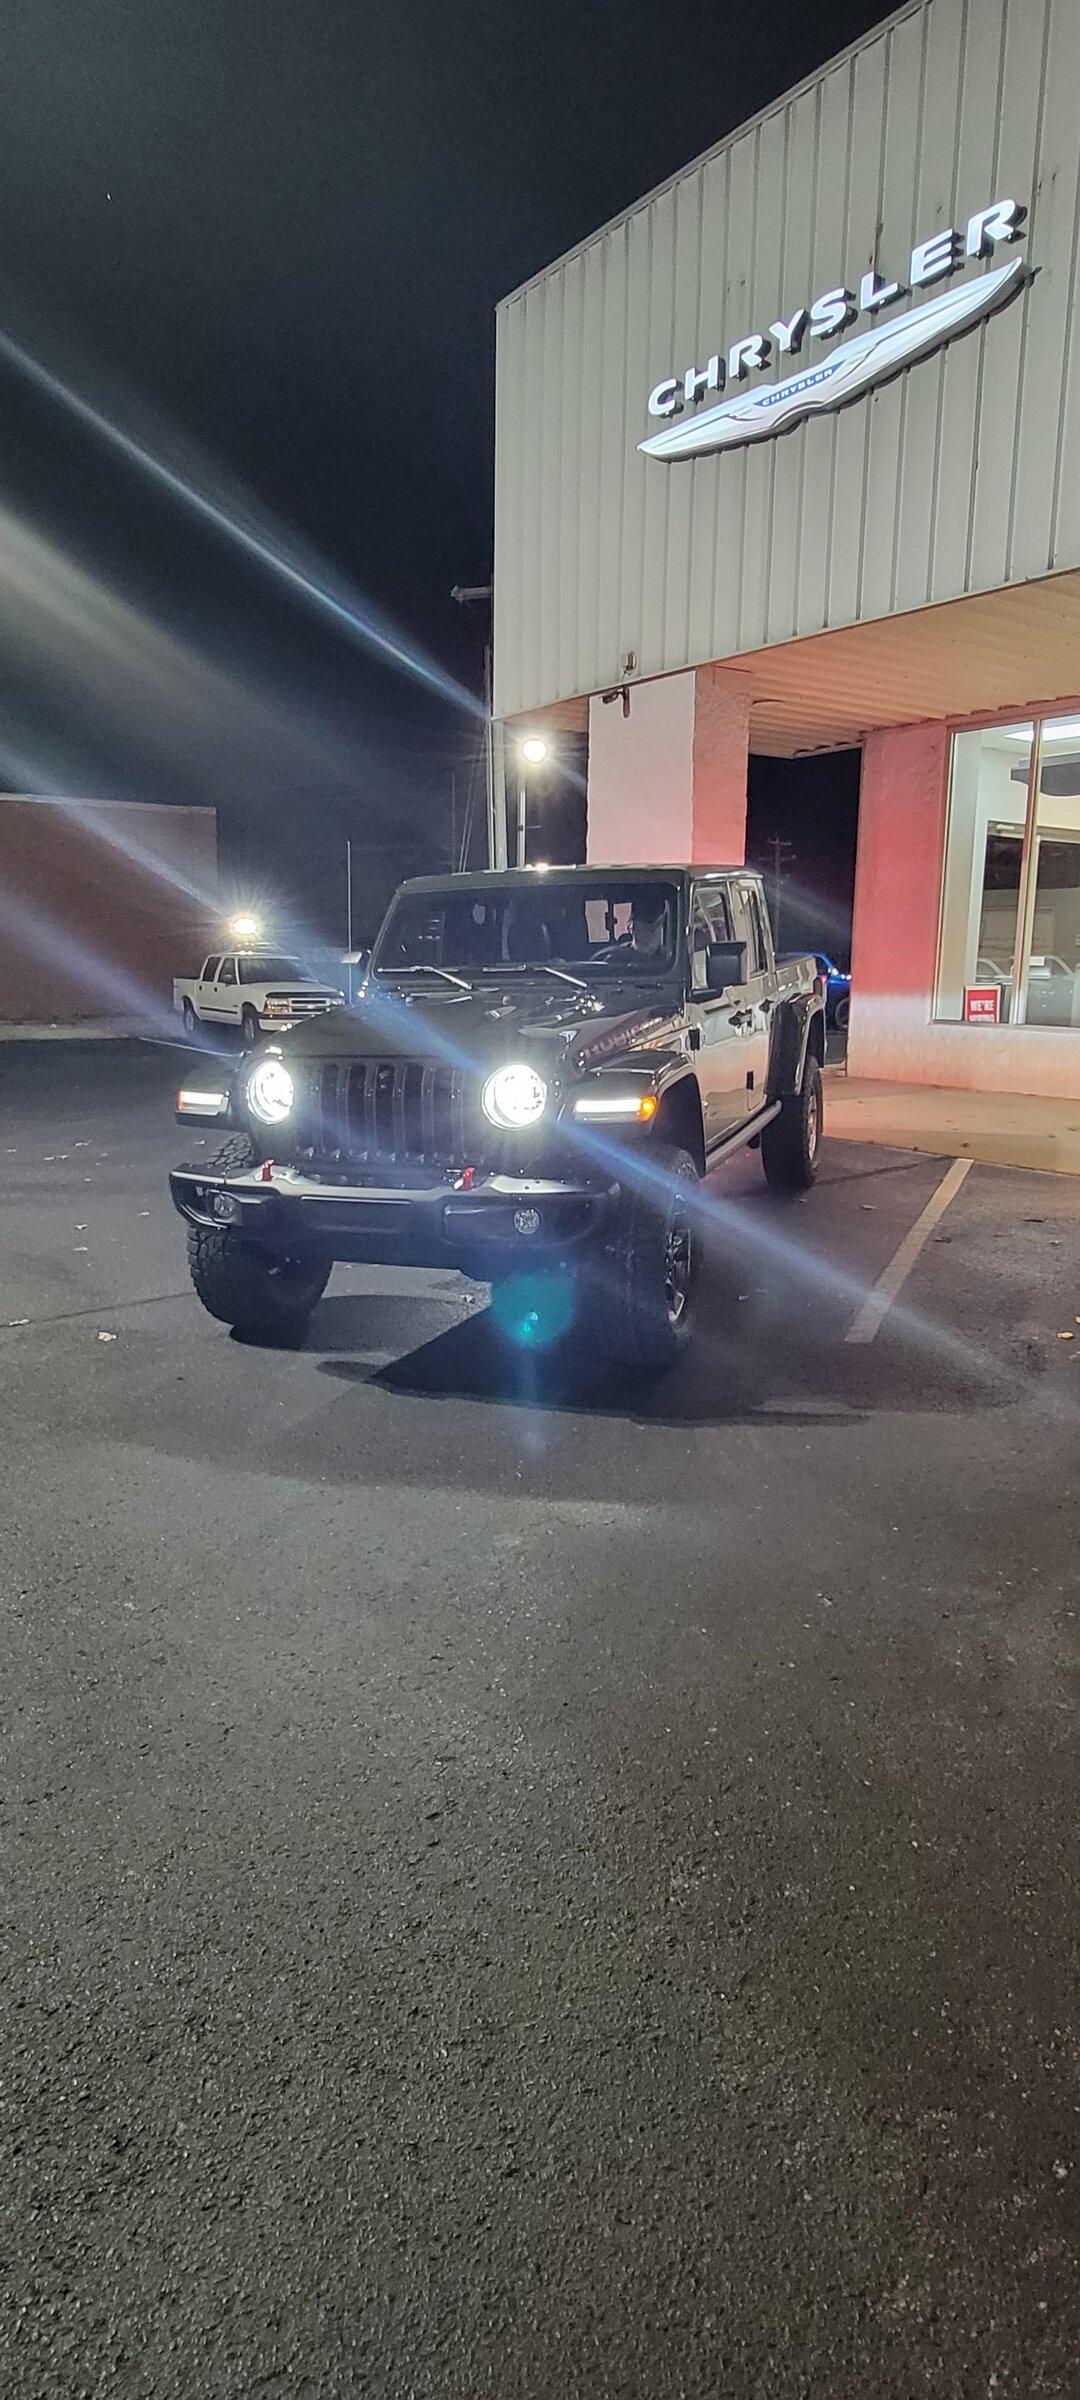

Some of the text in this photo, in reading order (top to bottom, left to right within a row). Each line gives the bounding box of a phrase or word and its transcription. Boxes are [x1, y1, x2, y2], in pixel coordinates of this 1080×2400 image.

[648, 199, 1018, 416] CHRYSLER
[761, 368, 834, 406] CHRYSLER
[583, 1017, 664, 1058] RUBIC
